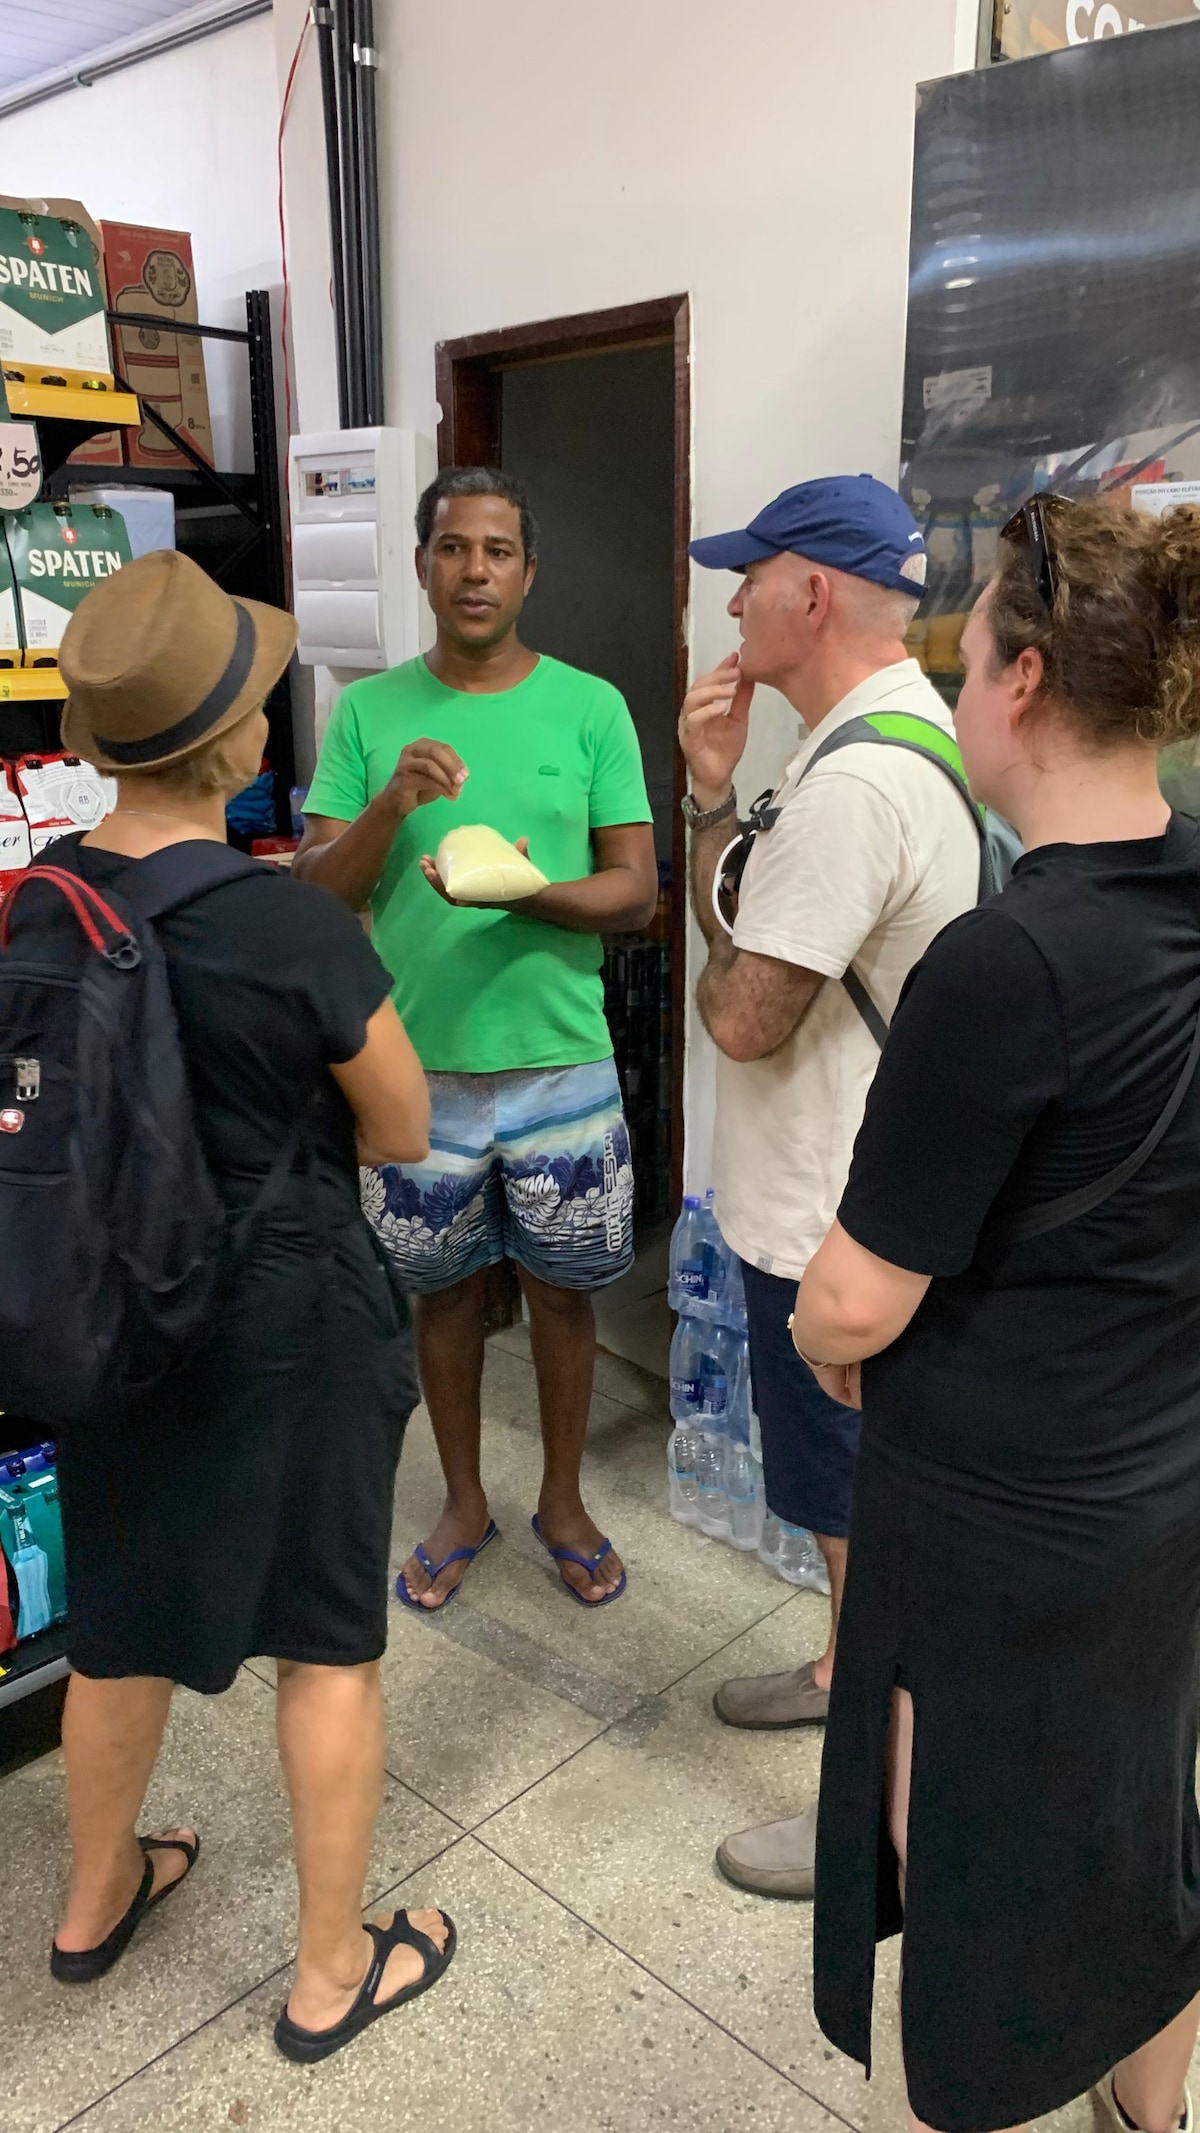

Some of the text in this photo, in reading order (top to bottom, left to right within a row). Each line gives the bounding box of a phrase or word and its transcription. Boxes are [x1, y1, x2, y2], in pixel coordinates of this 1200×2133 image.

[0, 254, 93, 297] SPATEN
[29, 291, 64, 304] MUNICH
[0, 446, 40, 479] ,50
[28, 548, 122, 578] SPATEN
[63, 580, 96, 588] MUNICH
